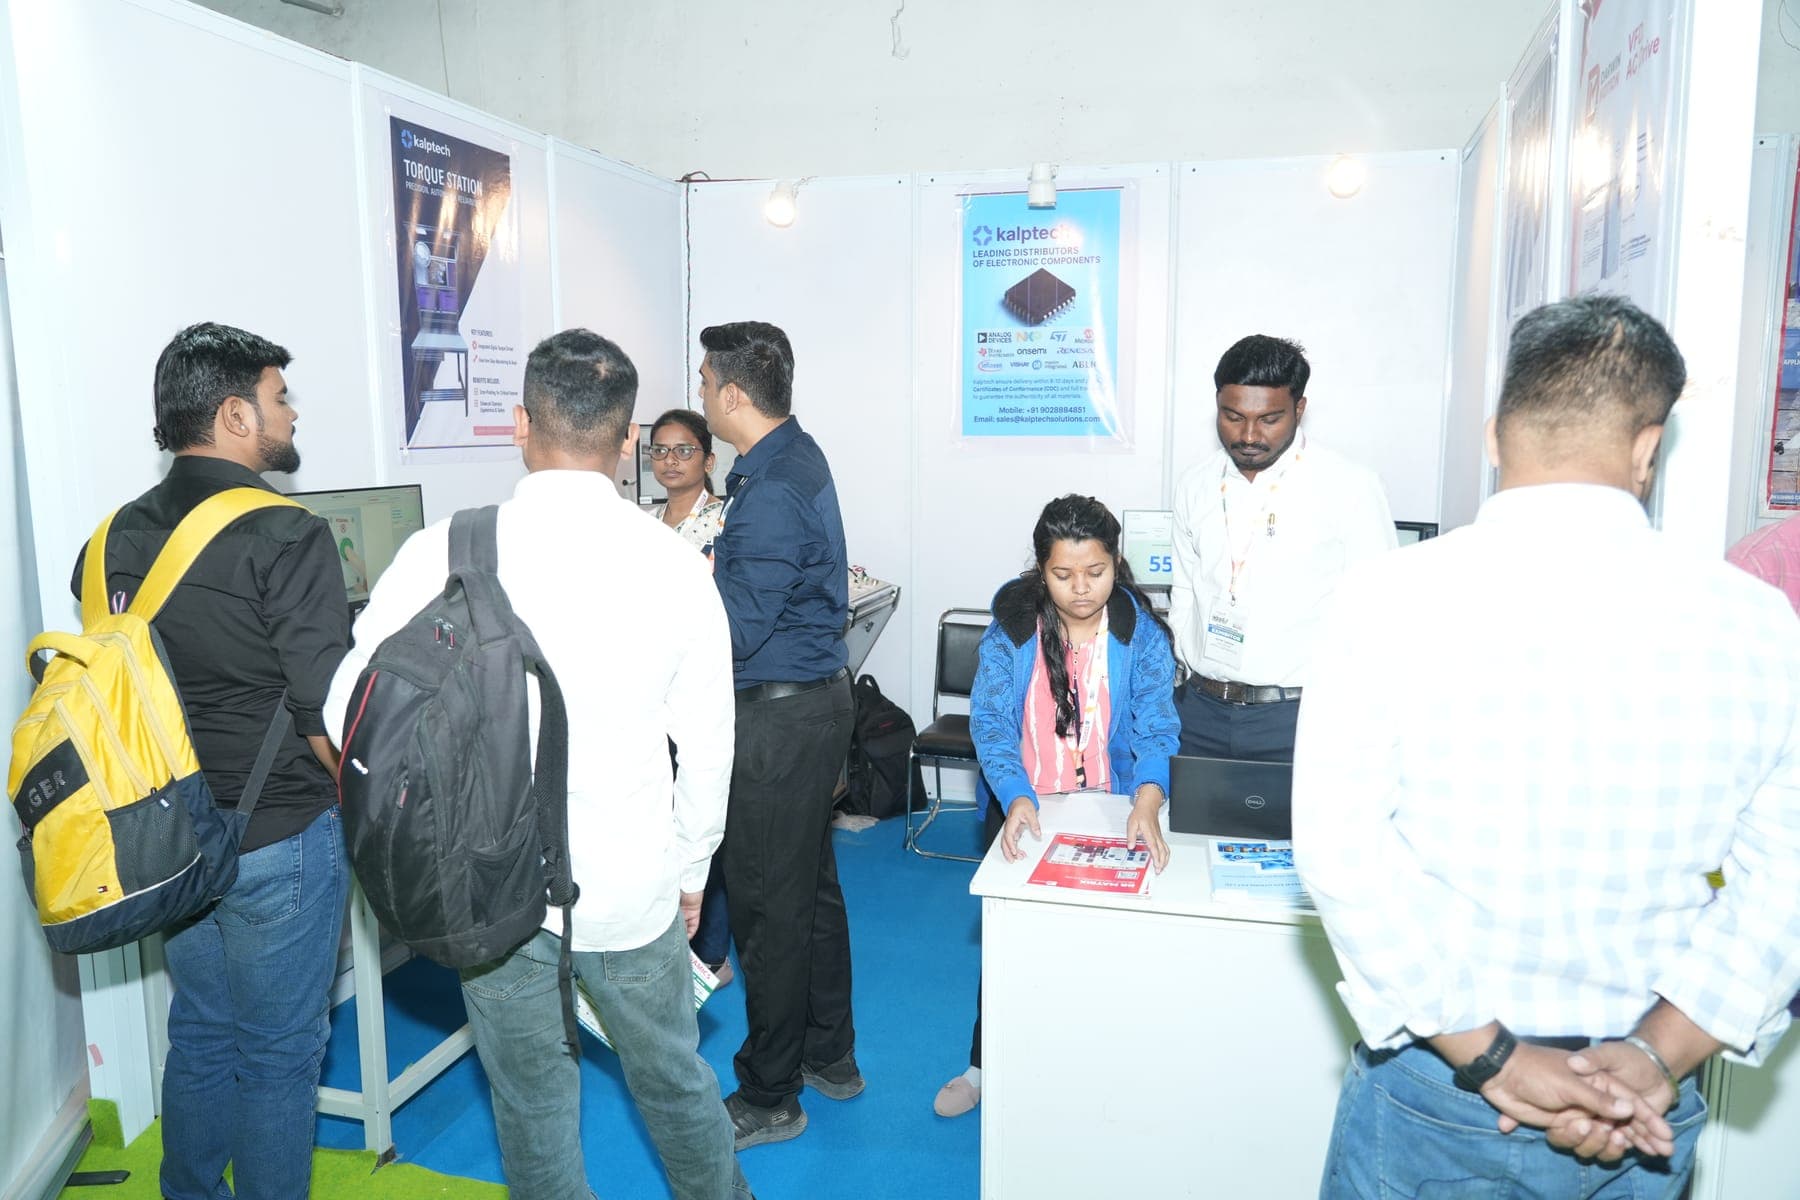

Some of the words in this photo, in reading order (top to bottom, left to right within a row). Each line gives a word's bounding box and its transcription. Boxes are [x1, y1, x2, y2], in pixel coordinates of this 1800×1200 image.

[413, 134, 451, 157] kalptech
[403, 159, 445, 185] TORQUE
[447, 171, 483, 197] STATION
[996, 225, 1066, 245] kalptec
[973, 249, 1011, 258] LEADING
[1013, 246, 1079, 257] DISTRIBUTORS
[972, 259, 984, 268] OF
[986, 258, 1039, 267] ELECTRONIC
[1040, 255, 1101, 266] COMPONENTS
[999, 406, 1025, 414] Mobile:
[973, 415, 995, 423] Email:
[996, 415, 1101, 424] sales@kalptechsolutions.com
[1149, 555, 1173, 573] 55
